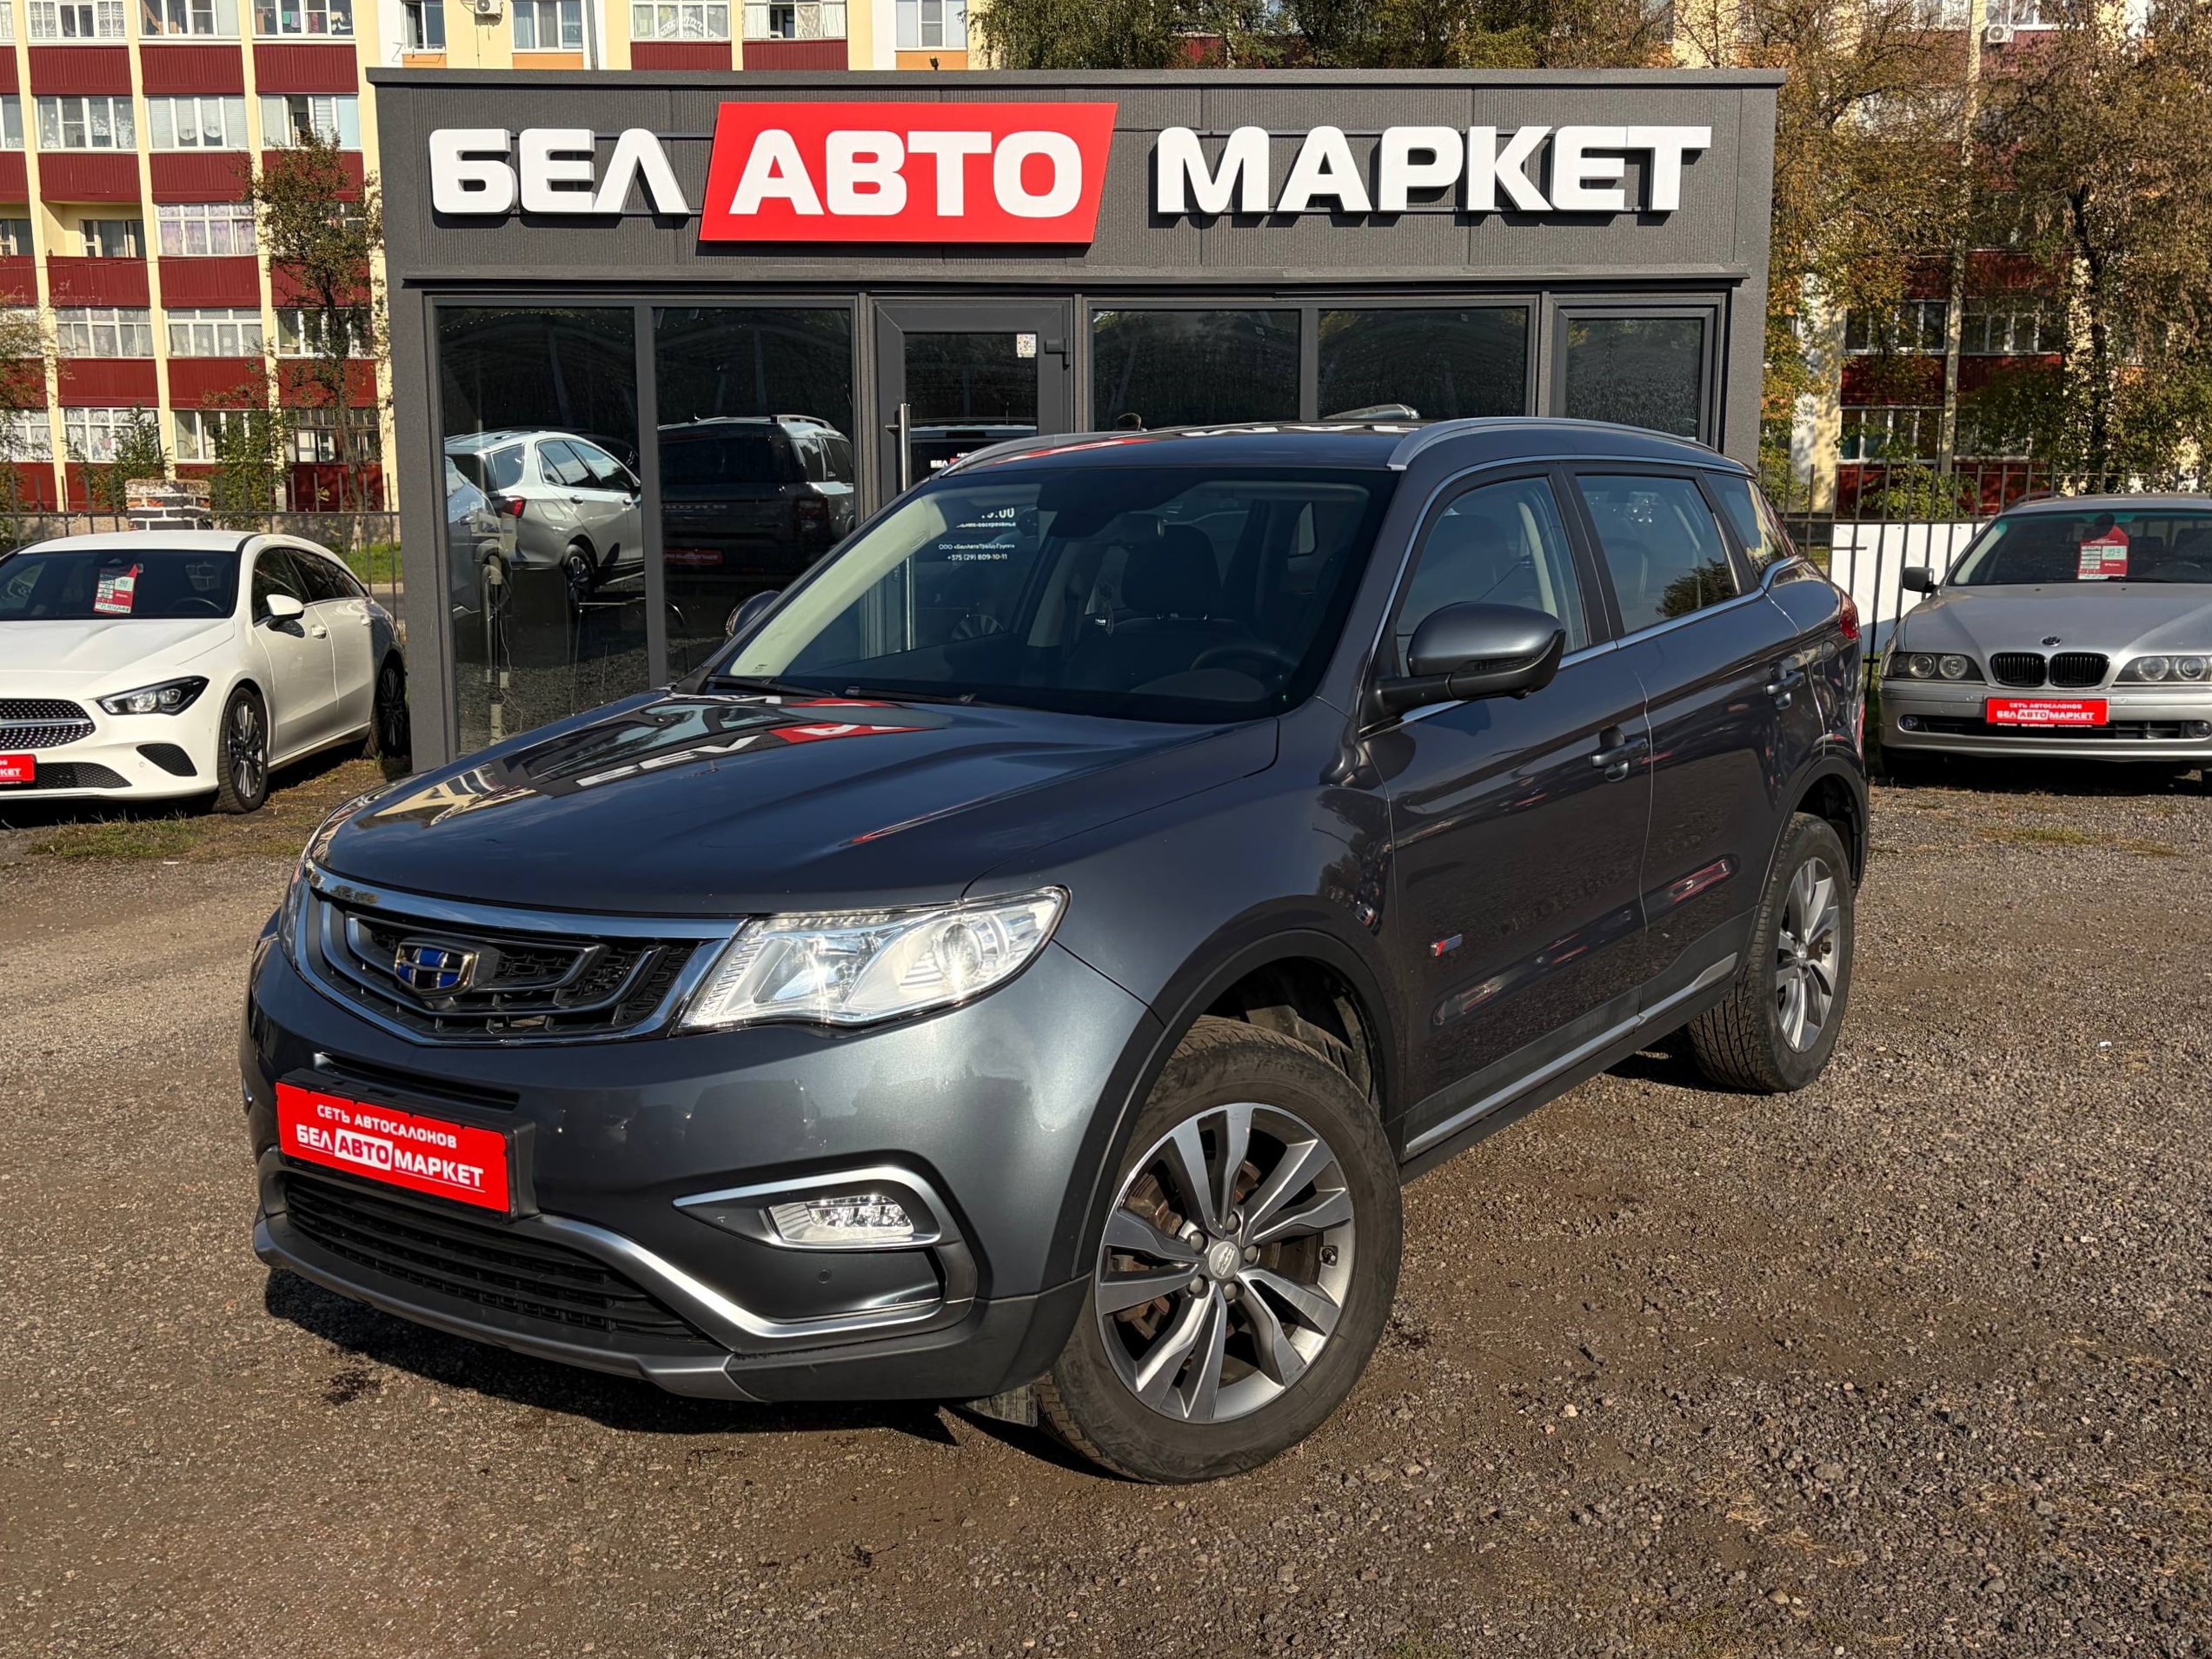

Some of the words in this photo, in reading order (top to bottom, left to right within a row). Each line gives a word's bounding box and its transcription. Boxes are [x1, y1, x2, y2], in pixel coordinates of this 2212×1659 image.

[429, 128, 690, 216] БЕЛ
[728, 129, 1084, 218] АВТО
[1157, 125, 1712, 214] МАРКЕТ
[316, 1105, 351, 1124] СЕТЬ
[355, 1113, 457, 1149] АВТОСАЛОНОВ
